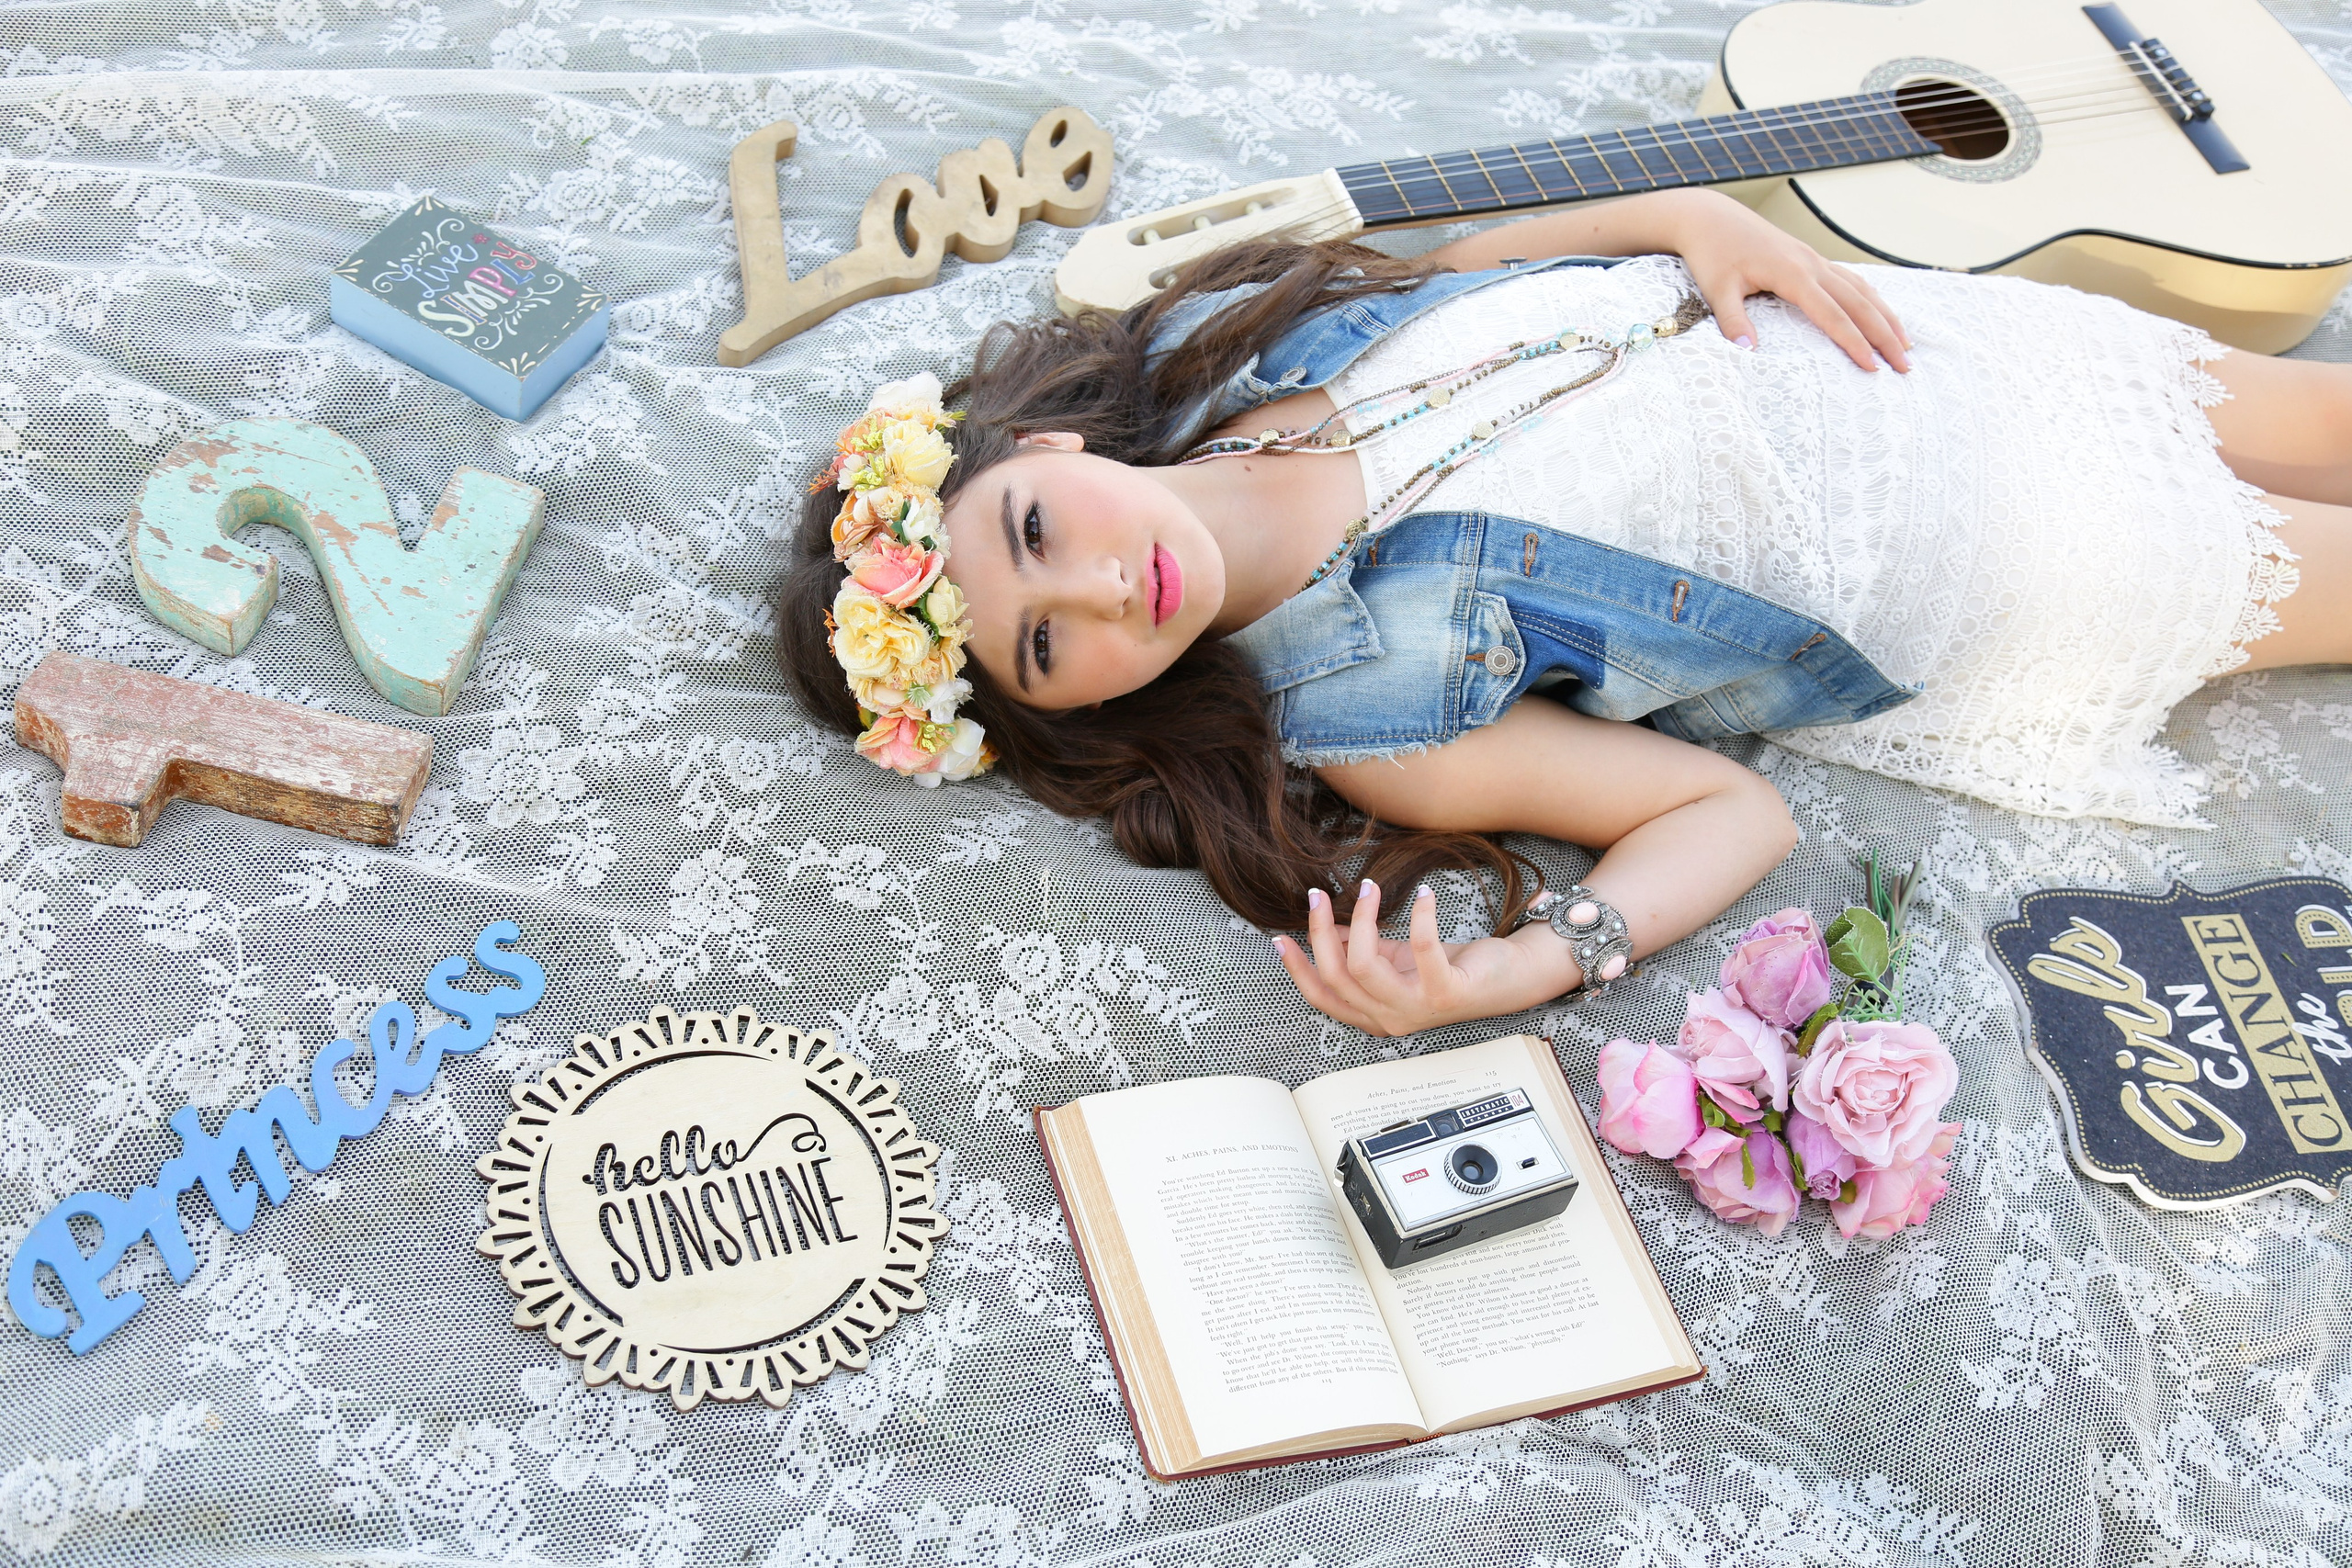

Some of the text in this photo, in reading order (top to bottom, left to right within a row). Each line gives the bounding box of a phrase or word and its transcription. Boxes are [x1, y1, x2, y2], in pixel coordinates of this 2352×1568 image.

[717, 107, 1114, 367] Love
[386, 243, 479, 299] Live
[128, 416, 547, 717] 2
[2028, 916, 2246, 1162] Girls
[2165, 983, 2249, 1089] CAN
[2192, 918, 2343, 1147] CHANGE
[2291, 993, 2352, 1066] the
[1461, 1097, 1510, 1118] INSTAMATIC
[1470, 1107, 1510, 1122] CAMERA
[1510, 1093, 1524, 1108] 104
[7, 919, 547, 1357] Princess
[582, 1112, 827, 1196] hello
[1181, 1149, 1211, 1161] ACHES,
[1212, 1145, 1239, 1156] PAINS,
[1241, 1144, 1259, 1153] AND
[1261, 1144, 1299, 1154] EMOTIONS
[1405, 1170, 1426, 1182] Kodak
[599, 1156, 858, 1289] SUNSHINE
[1407, 1284, 1432, 1295] Nobody
[1487, 1303, 1510, 1312] enough
[1551, 1291, 1570, 1299] plenty
[1537, 1285, 1553, 1294] good
[1559, 1280, 1579, 1288] doctor
[1416, 1326, 1443, 1339] perience
[1446, 1321, 1458, 1329] and
[1460, 1318, 1480, 1327] young
[1481, 1313, 1505, 1322] enough
[1521, 1303, 1551, 1314] interested
[1553, 1297, 1577, 1307] enough
